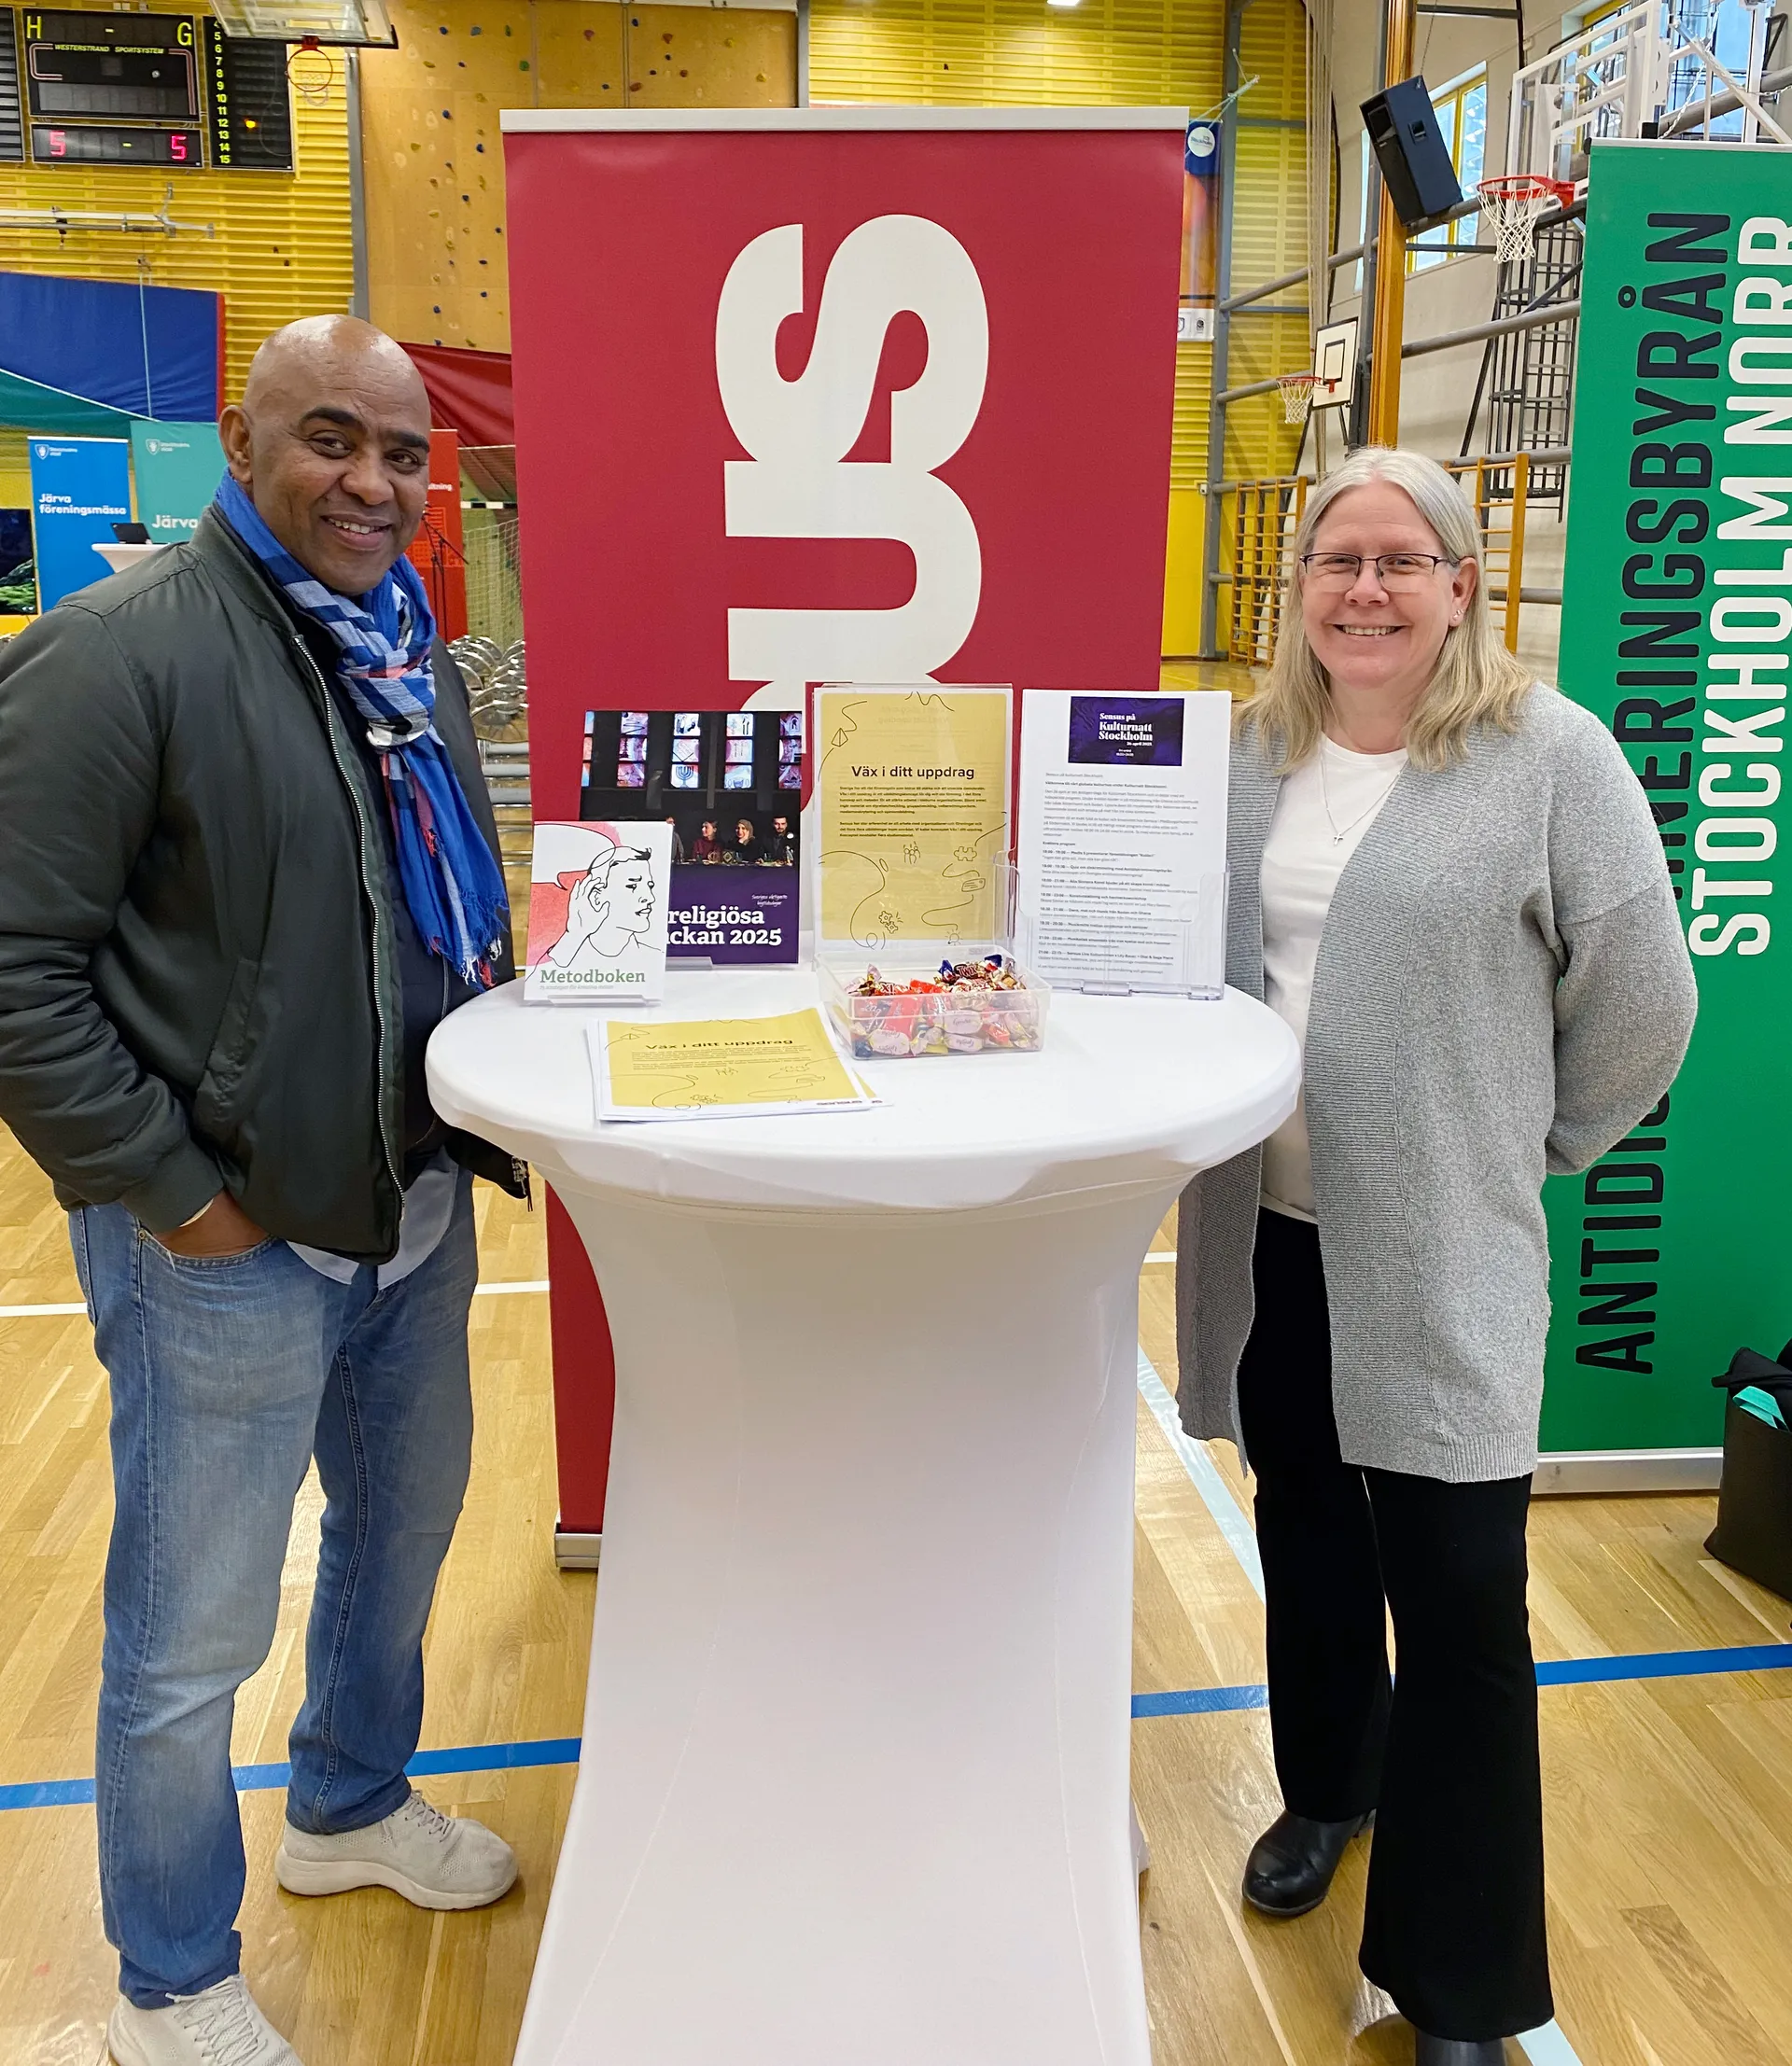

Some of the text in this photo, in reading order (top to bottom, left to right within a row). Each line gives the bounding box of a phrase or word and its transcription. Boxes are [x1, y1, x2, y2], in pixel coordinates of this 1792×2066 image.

[26, 15, 42, 39] H
[176, 21, 192, 46] G
[214, 31, 221, 41] 5
[115, 46, 164, 54] SPORTSYSTEM
[215, 44, 222, 53] 6
[215, 56, 223, 65] 7
[216, 69, 223, 78] 8
[217, 81, 224, 91] 9
[216, 93, 227, 104] 10
[217, 105, 227, 116] 11
[217, 119, 229, 128] 12
[218, 131, 230, 140] 13
[49, 130, 66, 157] 5
[171, 135, 187, 161] 5
[219, 143, 231, 152] 14
[219, 155, 231, 164] 15
[38, 493, 72, 504] Järva
[39, 504, 127, 516] föreningsmässa
[152, 514, 199, 529] Järva
[1126, 714, 1136, 722] på
[1687, 484, 1792, 957] STOCKHOLM
[1099, 721, 1152, 732] Kulturnatt
[1099, 731, 1153, 741] Stockholm
[851, 765, 974, 779] Väx i ditt uppdrag
[730, 928, 782, 946] 2025
[539, 969, 646, 984] Metodboken
[693, 1040, 720, 1048] ditt
[724, 1038, 793, 1047] uppdrag
